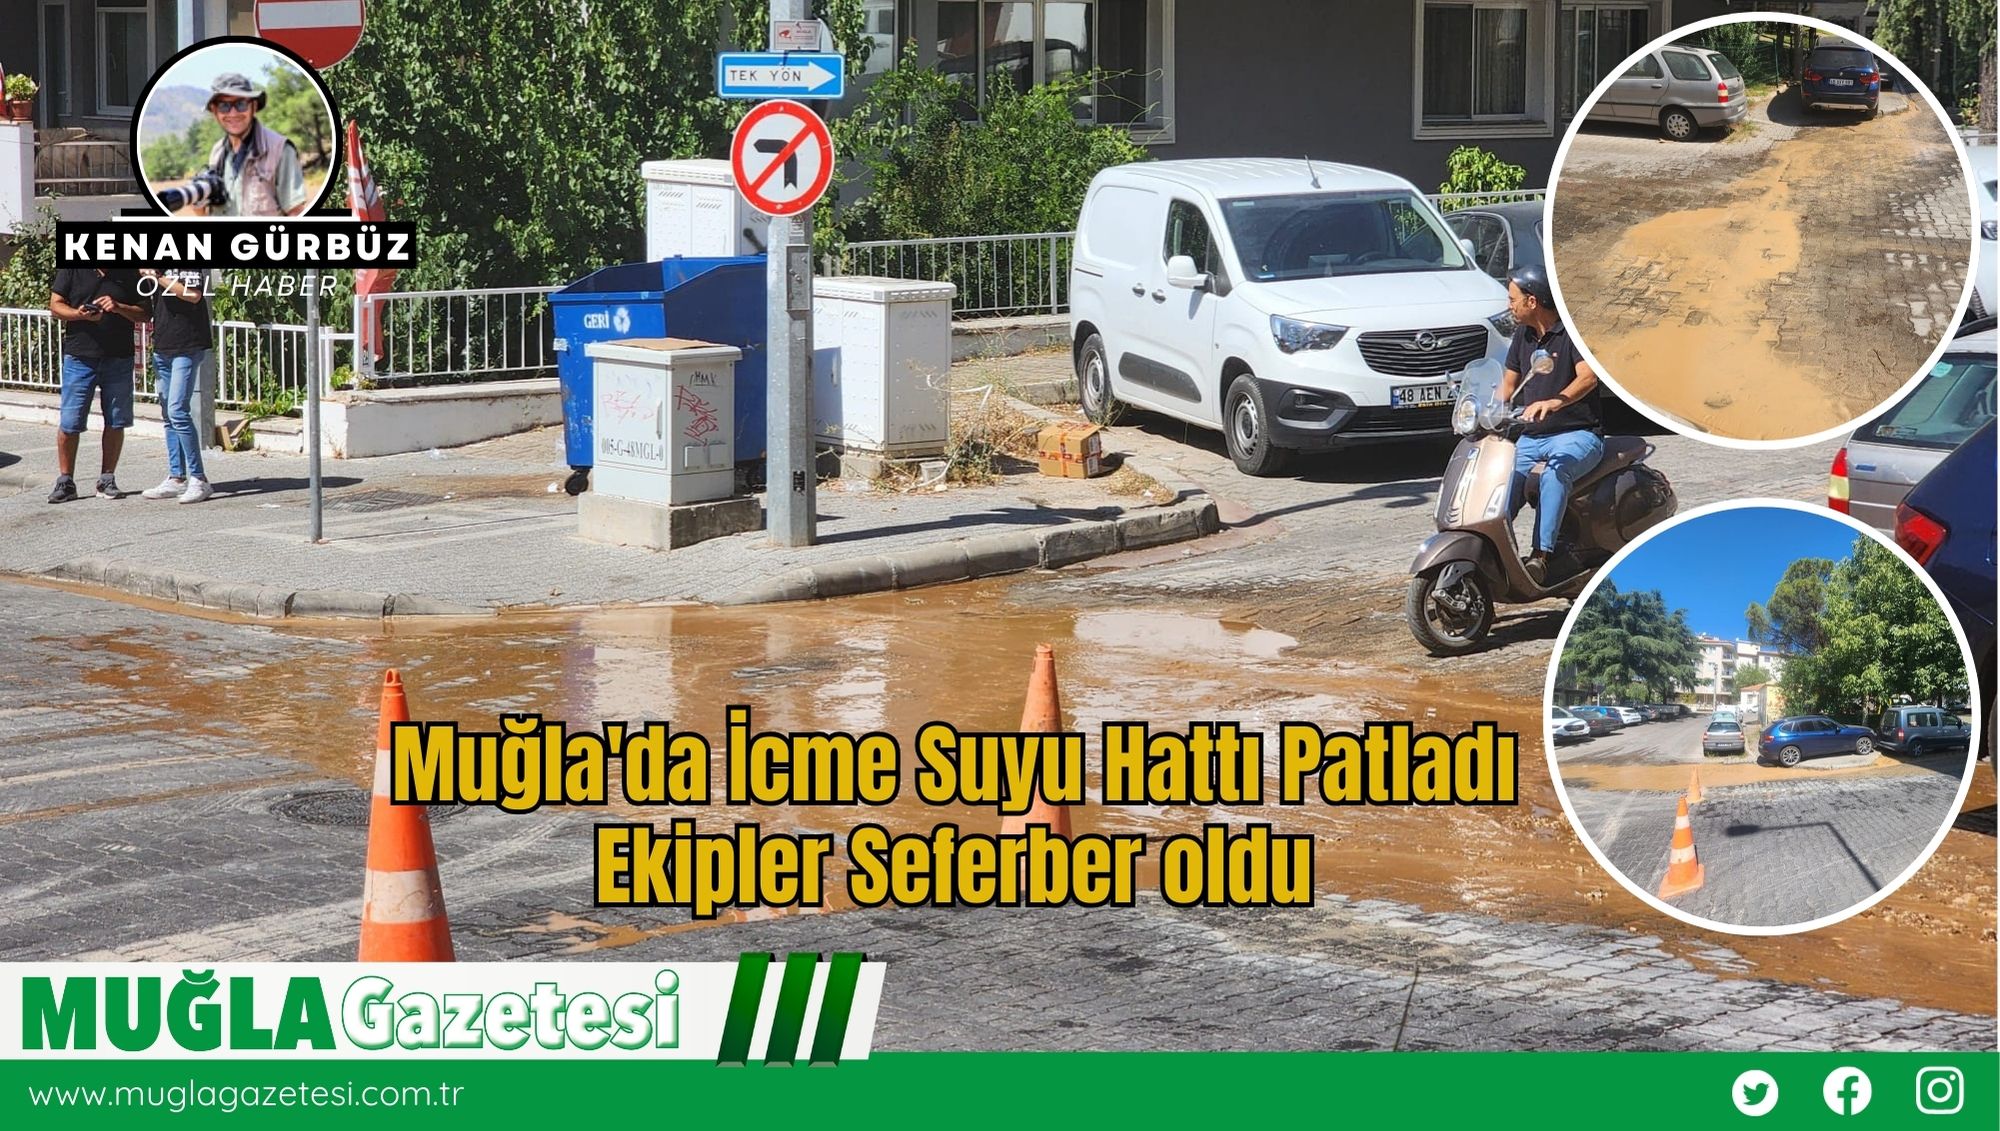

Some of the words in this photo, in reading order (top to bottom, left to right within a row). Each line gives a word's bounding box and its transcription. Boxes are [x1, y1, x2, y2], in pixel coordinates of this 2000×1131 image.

[729, 69, 758, 81] TEK
[769, 67, 801, 81] YÖN
[583, 310, 610, 329] GERİ
[1399, 388, 1415, 403] 48
[1420, 386, 1442, 401] AEN
